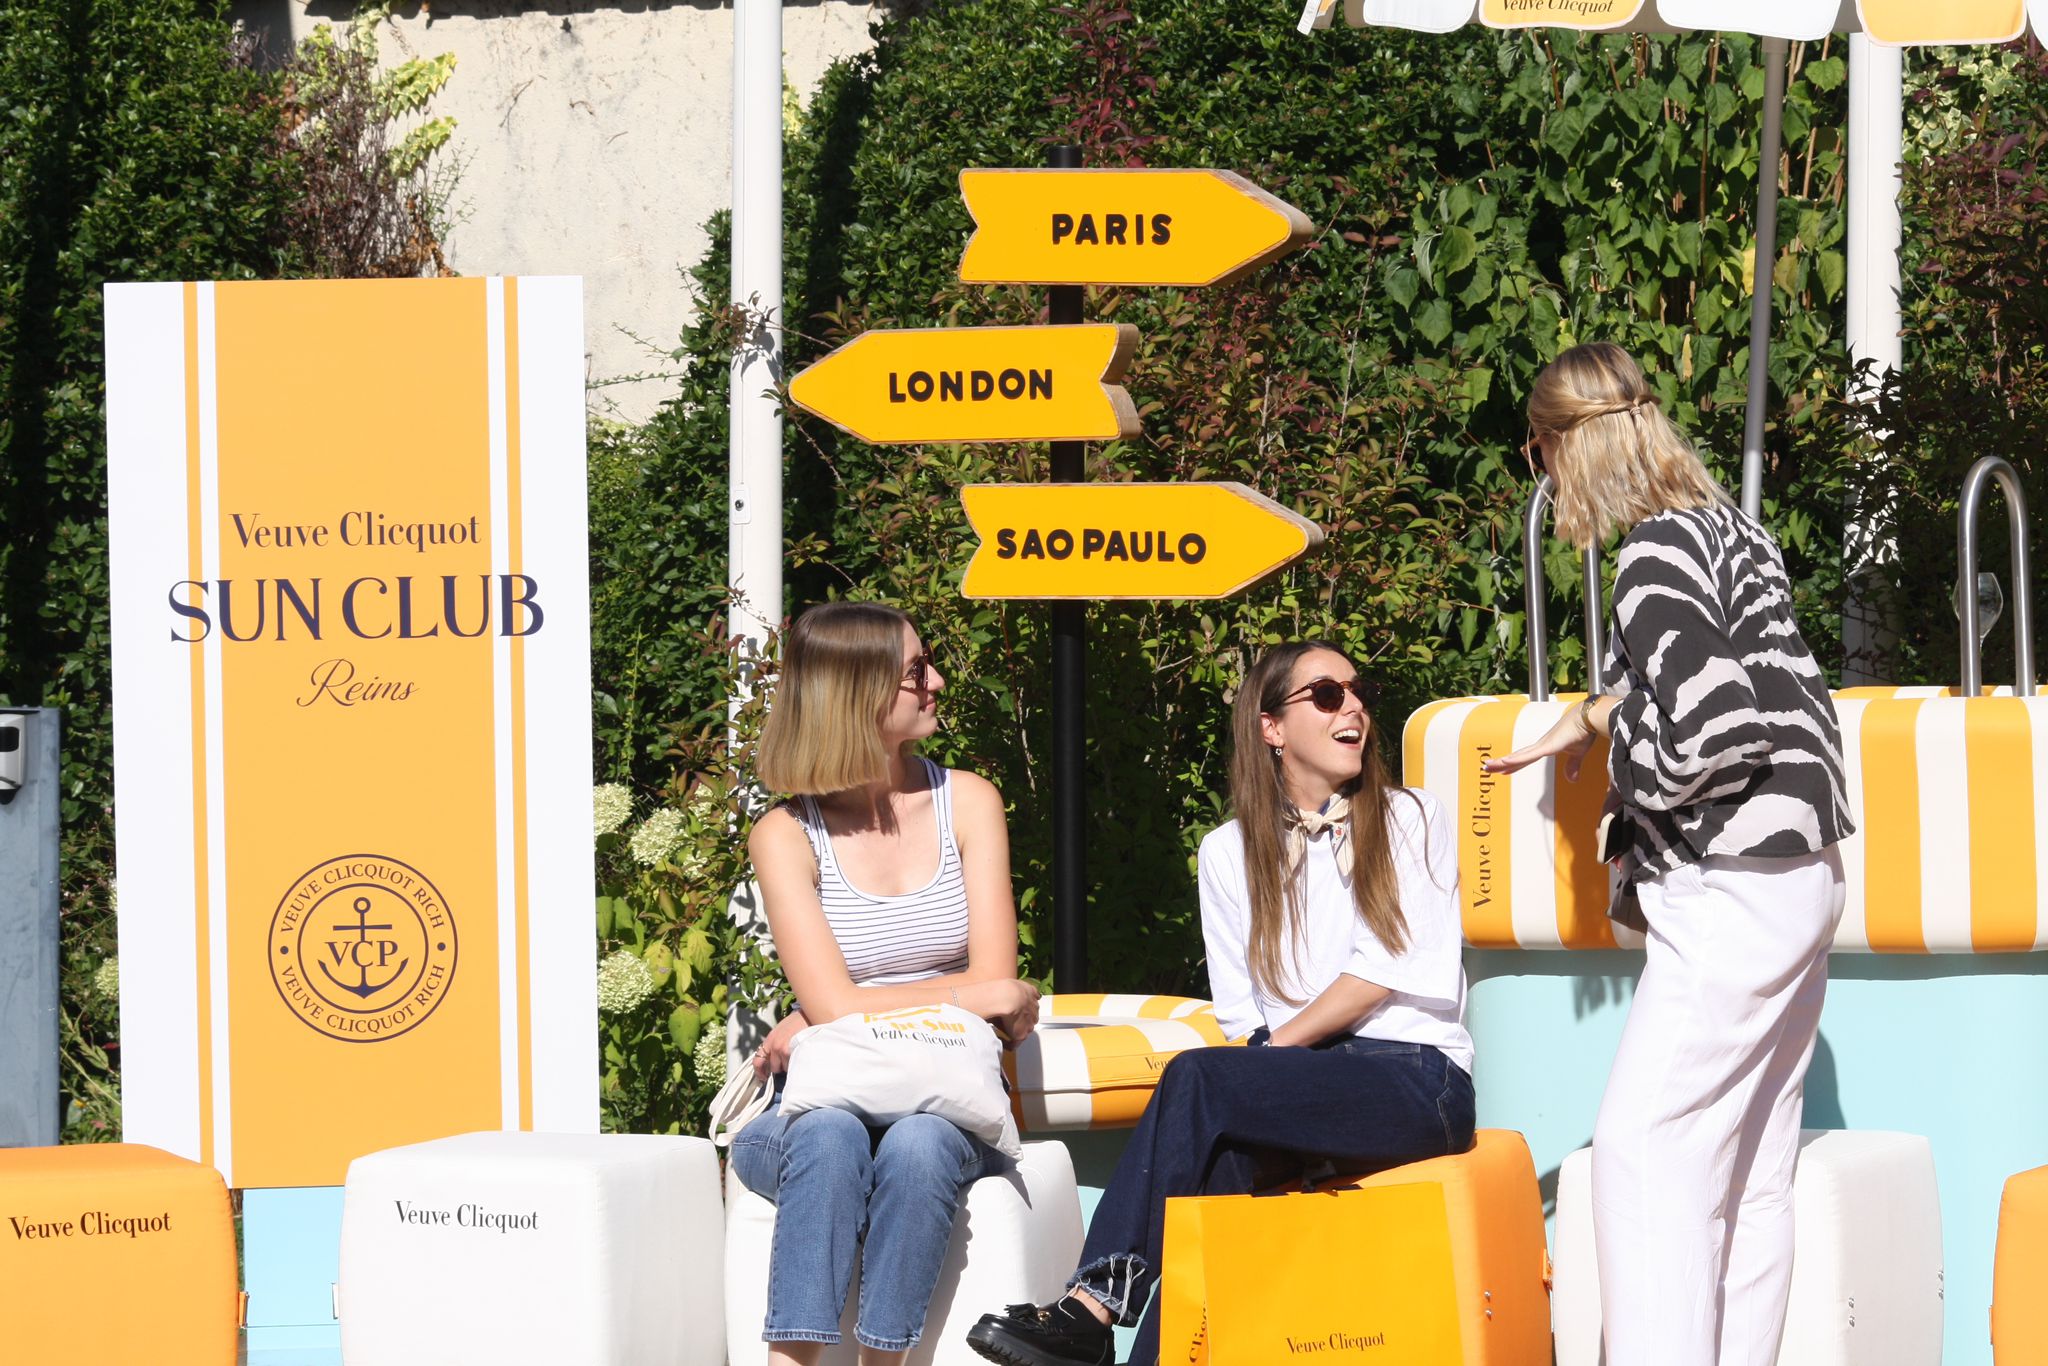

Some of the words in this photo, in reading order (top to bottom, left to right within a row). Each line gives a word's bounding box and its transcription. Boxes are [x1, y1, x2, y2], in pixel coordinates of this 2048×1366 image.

[1050, 213, 1174, 246] PARIS
[887, 368, 1054, 403] LONDON
[229, 513, 330, 548] Veuve
[338, 511, 480, 553] Clicquot
[995, 527, 1076, 561] SAO
[1081, 528, 1208, 565] PAULO
[167, 575, 326, 643] SUN
[341, 573, 546, 640] CLUB
[295, 658, 418, 707] Reims
[1472, 844, 1492, 909] Veuve
[280, 880, 322, 933] VEUVE
[323, 863, 415, 890] CLICQUOT
[412, 887, 445, 929] RICH
[324, 940, 399, 968] VCP
[281, 966, 324, 1019] VEUVE
[326, 1003, 416, 1034] CLICQUOT
[414, 964, 445, 1007] RICH
[912, 1031, 968, 1048] Clicquot
[8, 1216, 75, 1240] Veuve
[79, 1211, 171, 1239] Clicquot
[394, 1200, 452, 1226] Veuve
[455, 1203, 539, 1234] Clicquot
[1286, 1337, 1326, 1354] Veuve
[1328, 1332, 1386, 1352] Clicquot
